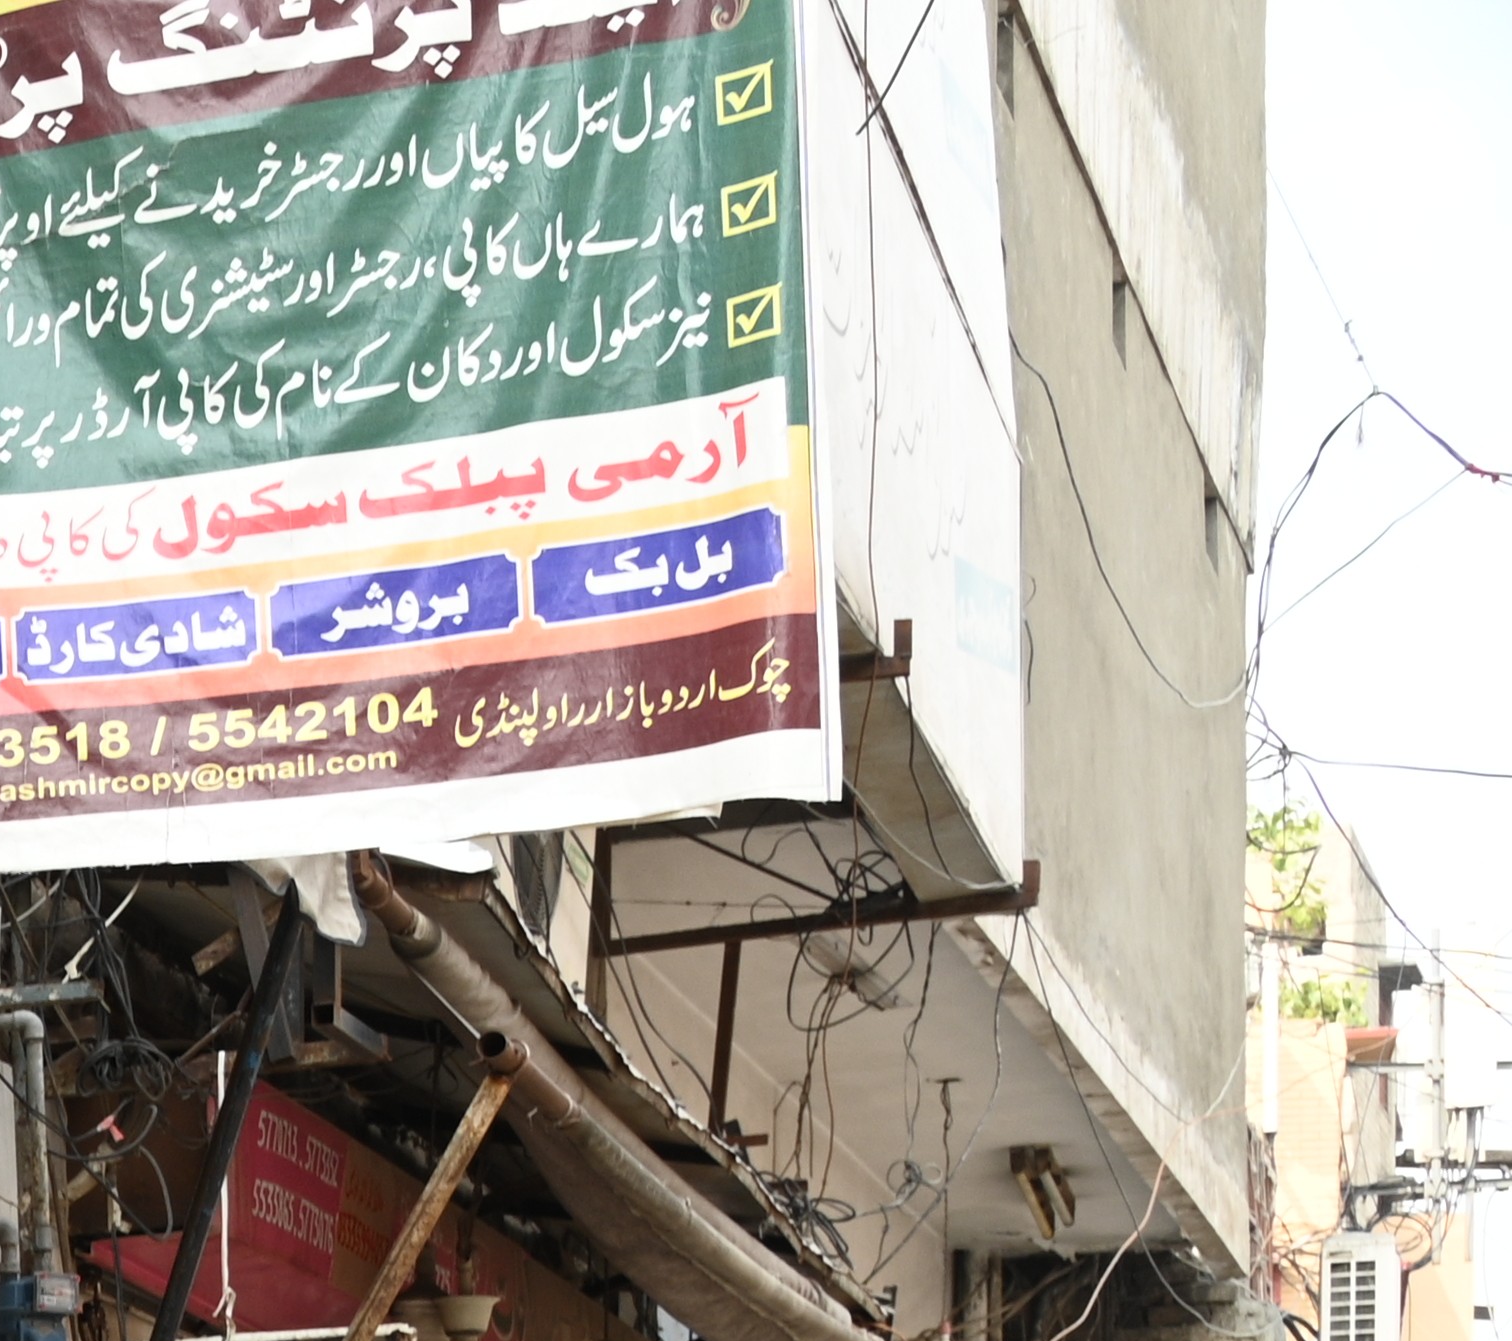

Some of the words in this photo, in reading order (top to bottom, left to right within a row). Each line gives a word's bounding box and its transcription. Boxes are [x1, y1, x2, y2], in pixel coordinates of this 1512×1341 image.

[500, 321, 557, 382] اور
[560, 275, 665, 377] سکول
[657, 291, 712, 366] نیز
[232, 338, 286, 426] کی
[333, 332, 401, 405] کے
[407, 323, 501, 402] دکان
[61, 369, 160, 444] آرڈر
[157, 361, 237, 455] کاپی
[275, 358, 332, 438] نام
[22, 410, 55, 468] پر
[567, 392, 759, 502] آرمی
[153, 481, 348, 559] سکول
[360, 457, 546, 521] پبلک
[17, 506, 104, 582] کاپی
[101, 485, 157, 560] کی
[585, 547, 670, 599] بک
[675, 536, 733, 590] بل
[26, 615, 117, 674] کارڈ
[119, 606, 248, 667] شادی
[321, 582, 471, 643] بروشر
[658, 669, 717, 716] اردو
[718, 637, 792, 703] چوک
[188, 686, 440, 752] 5542104
[454, 687, 586, 748] راولپنڈی
[584, 680, 655, 730] بازار
